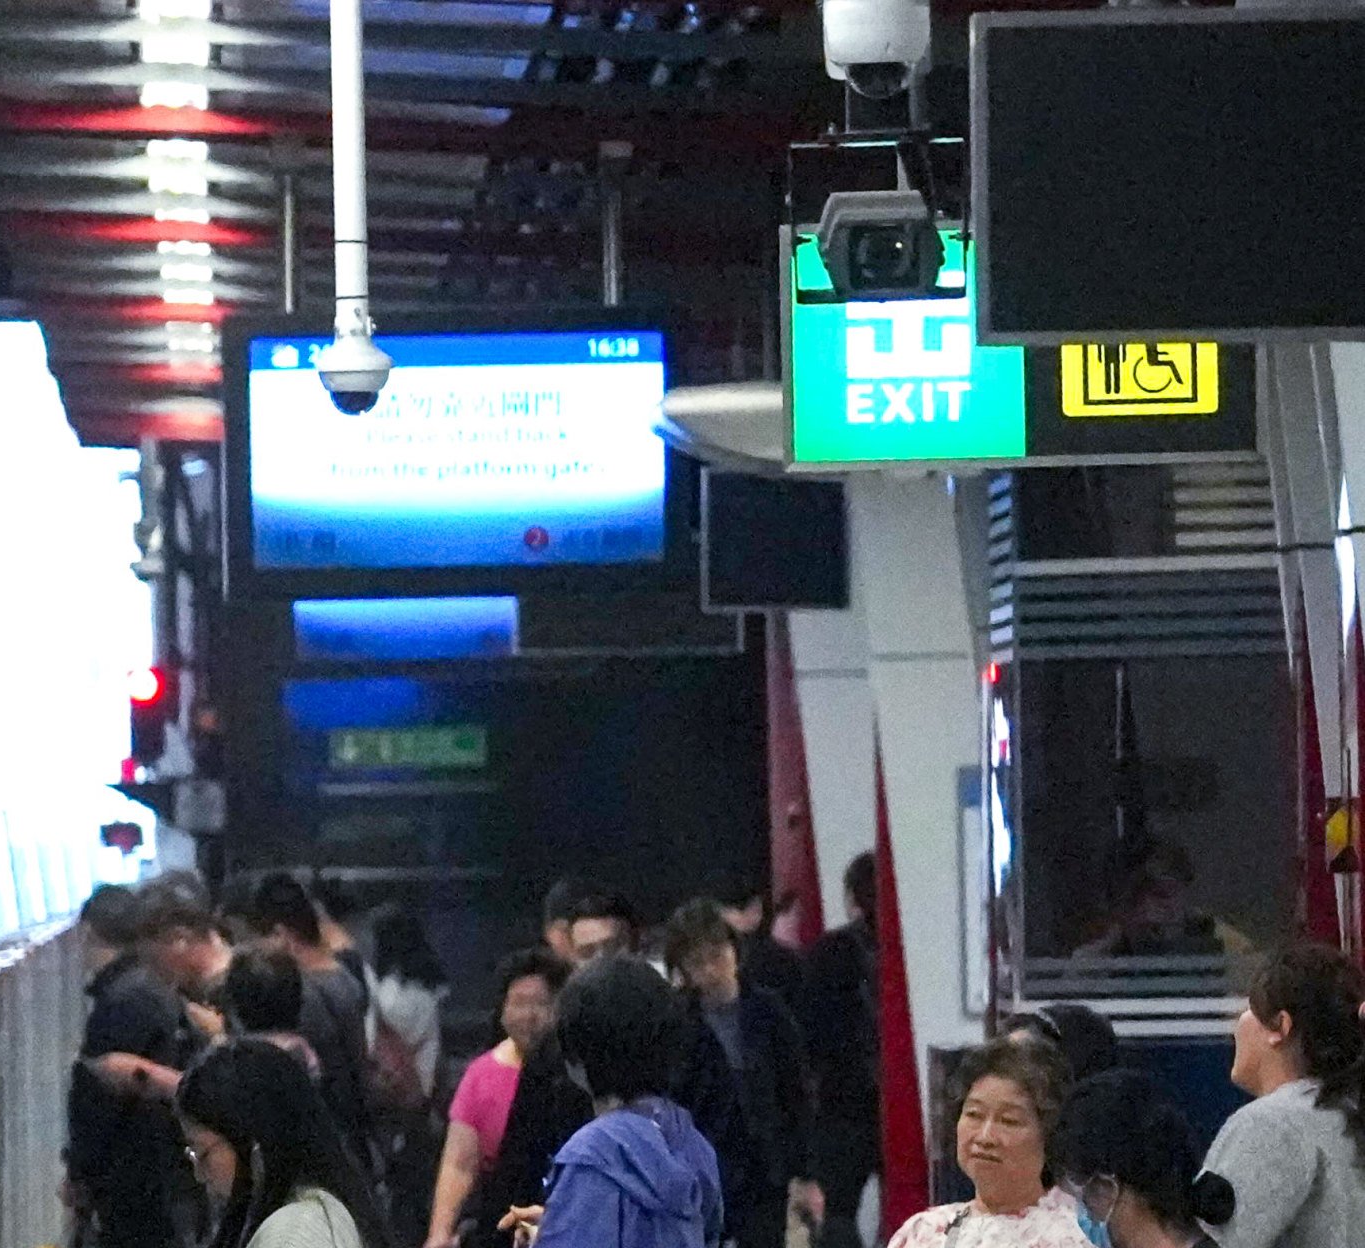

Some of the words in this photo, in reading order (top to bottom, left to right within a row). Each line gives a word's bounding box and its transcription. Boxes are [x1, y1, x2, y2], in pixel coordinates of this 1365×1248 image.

[846, 382, 971, 424] EXIT
[392, 460, 429, 477] the
[437, 459, 539, 480] platform
